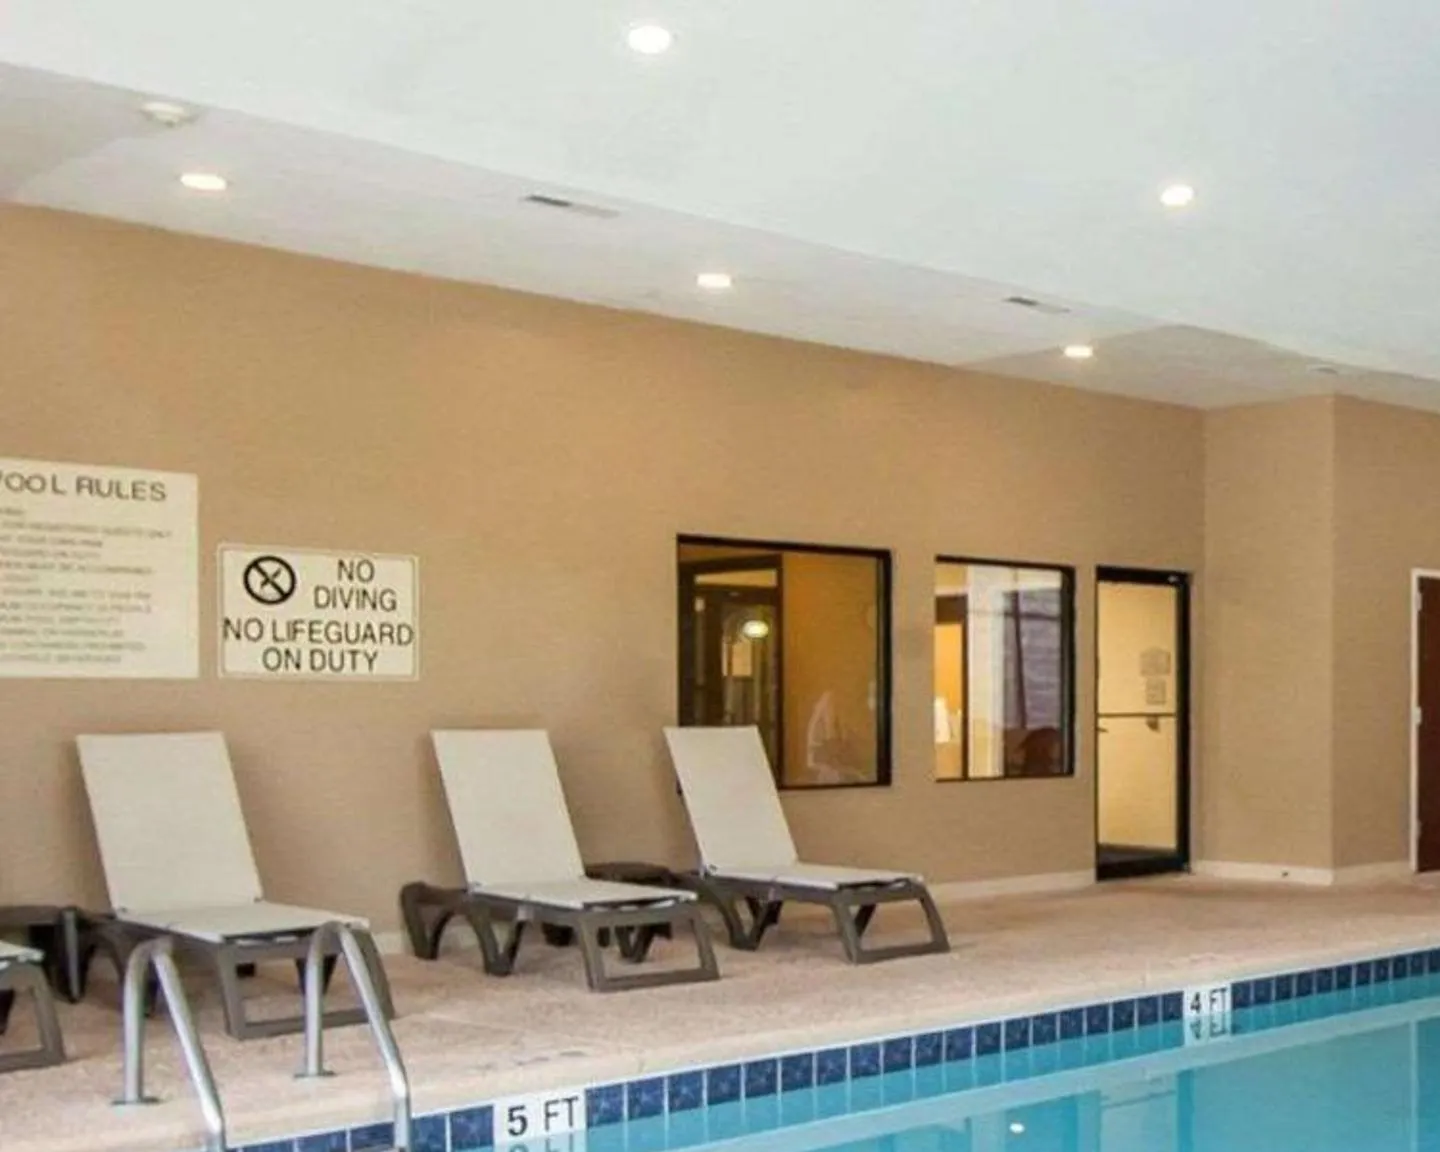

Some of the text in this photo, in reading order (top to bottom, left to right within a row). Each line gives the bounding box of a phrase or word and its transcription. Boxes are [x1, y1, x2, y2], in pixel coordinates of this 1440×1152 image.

[0, 470, 167, 501] OOL RULES
[338, 559, 375, 583] NO
[313, 585, 397, 612] DIVING
[223, 617, 414, 646] NO LIFEGUARD
[262, 646, 378, 672] ON DUTY
[1190, 992, 1201, 1014] 4
[507, 1095, 579, 1136] 5 FT
